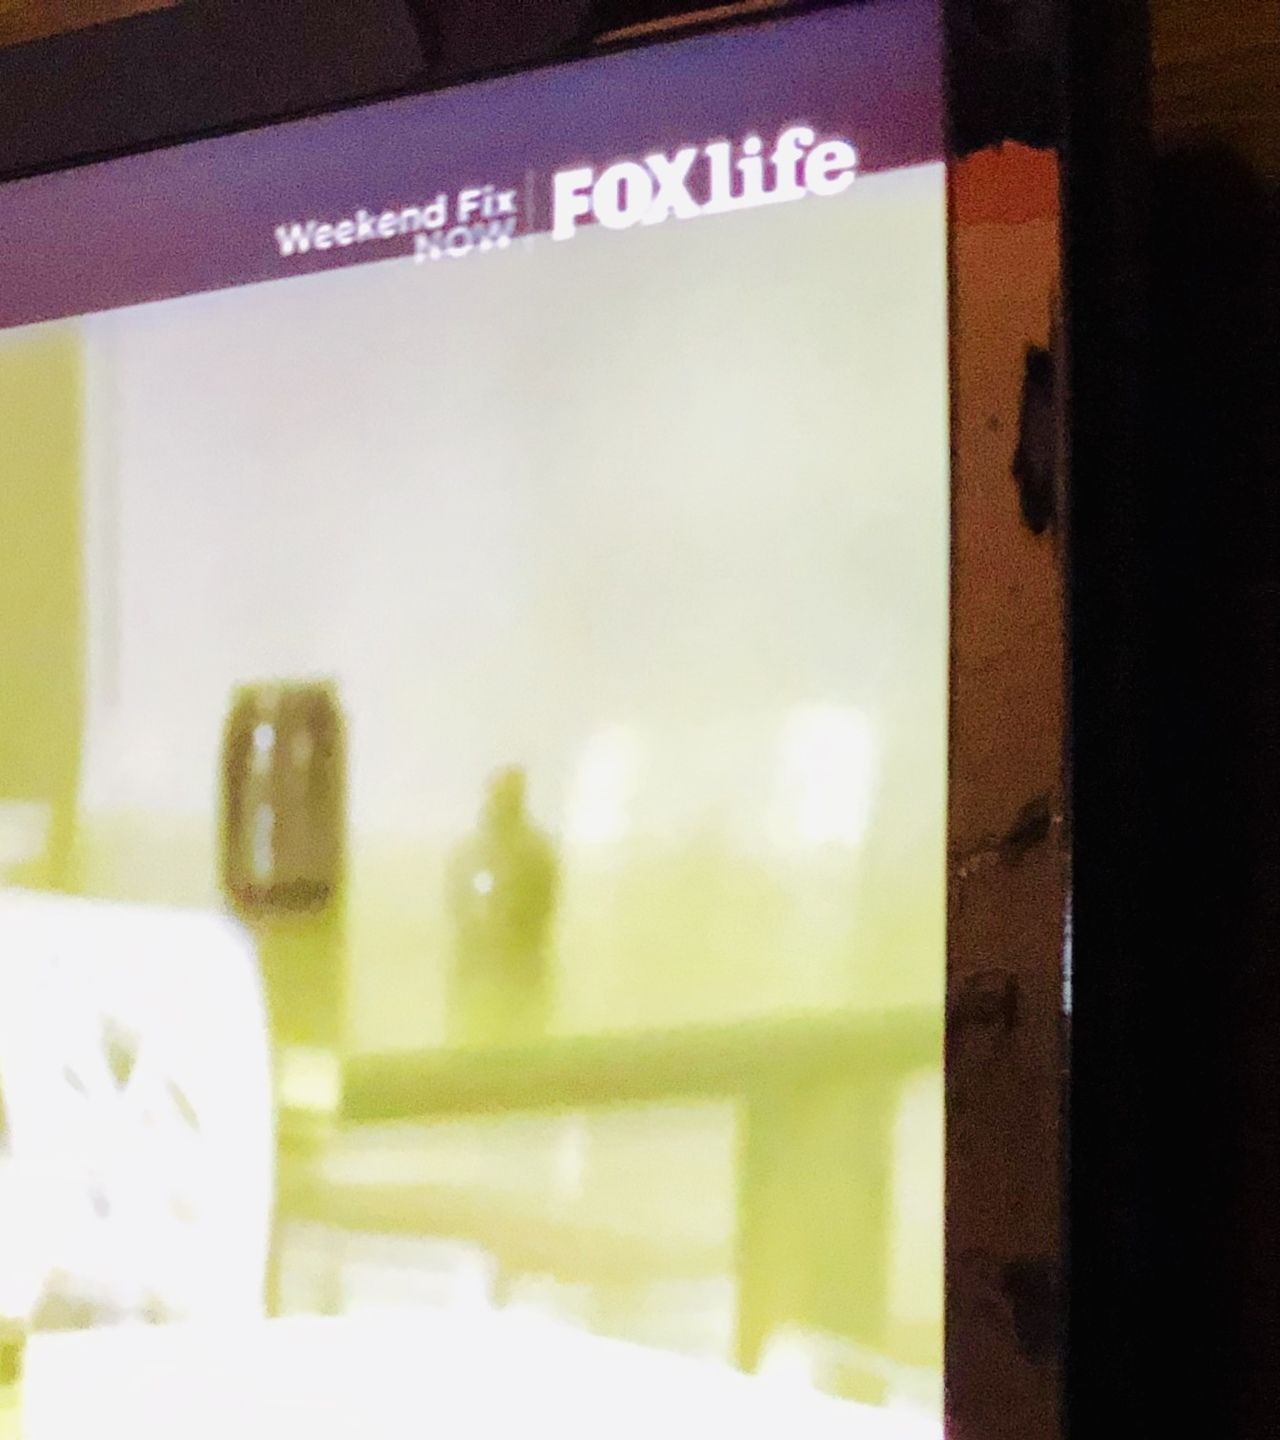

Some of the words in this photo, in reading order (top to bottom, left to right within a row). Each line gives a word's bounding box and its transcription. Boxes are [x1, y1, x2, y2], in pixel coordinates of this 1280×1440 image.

[275, 193, 448, 256] Weekend
[456, 184, 517, 223] Fix
[413, 216, 517, 264] NOW
